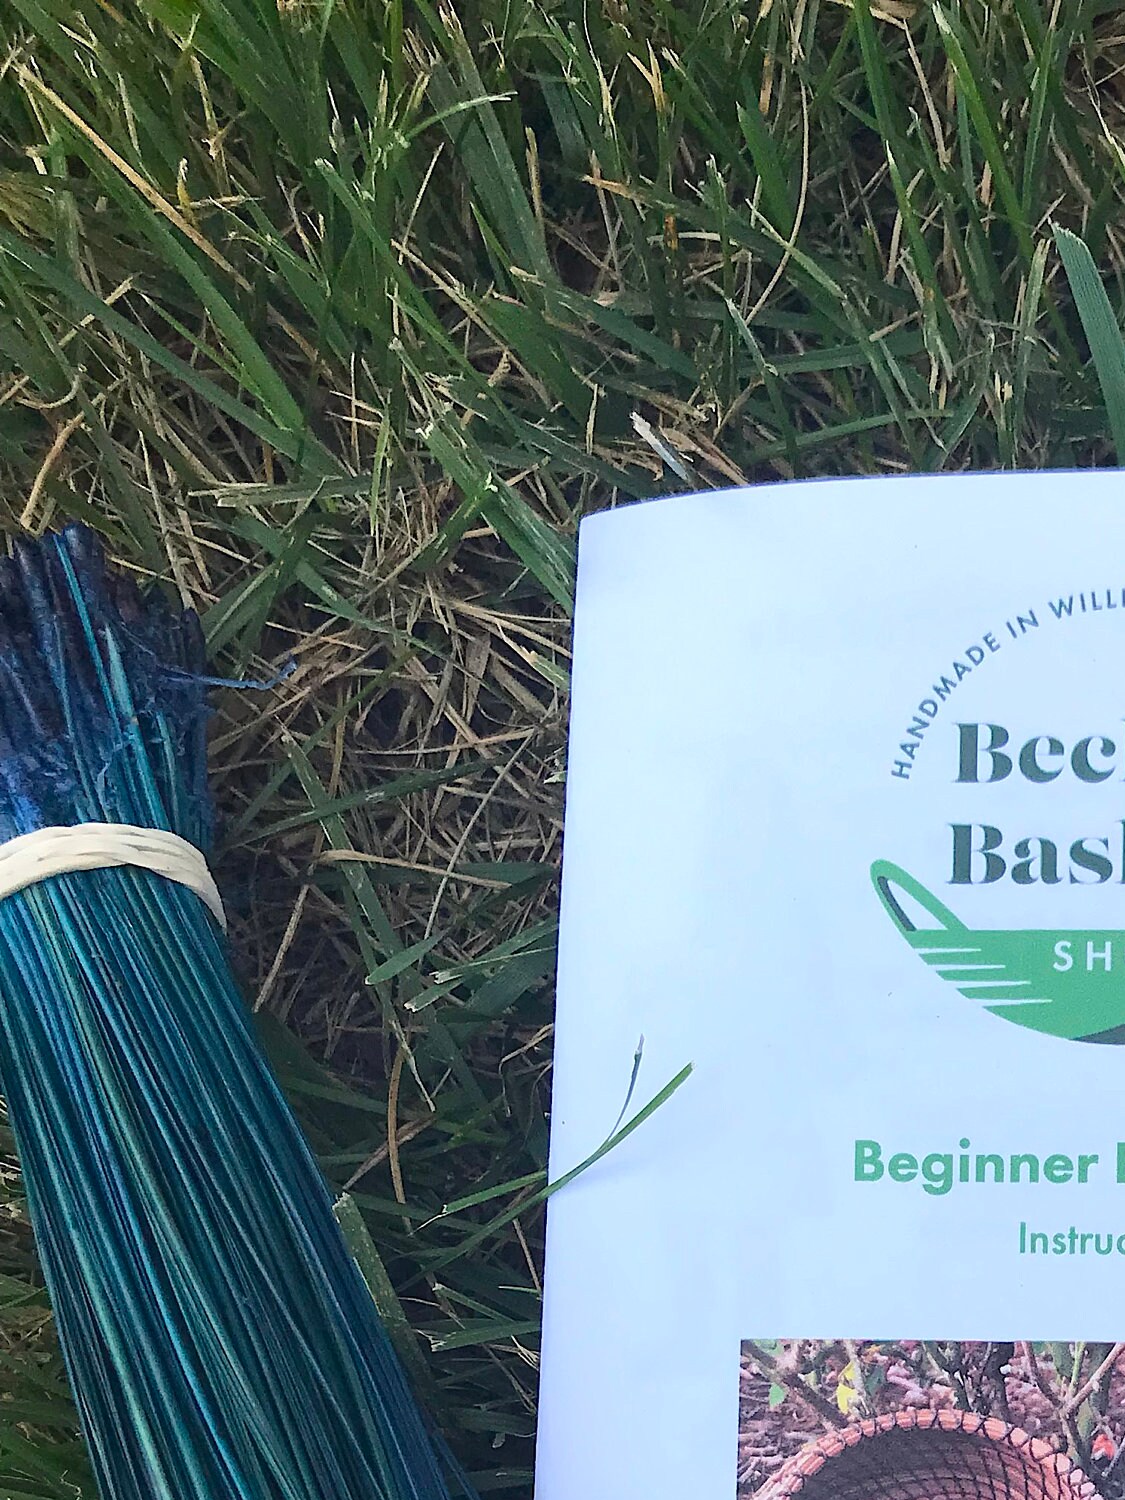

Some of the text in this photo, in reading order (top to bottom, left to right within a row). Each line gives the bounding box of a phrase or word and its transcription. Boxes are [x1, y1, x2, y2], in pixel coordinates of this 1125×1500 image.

[891, 632, 1001, 780] HANDMADE
[1005, 608, 1040, 639] IN
[854, 1138, 1100, 1196] Beginner
